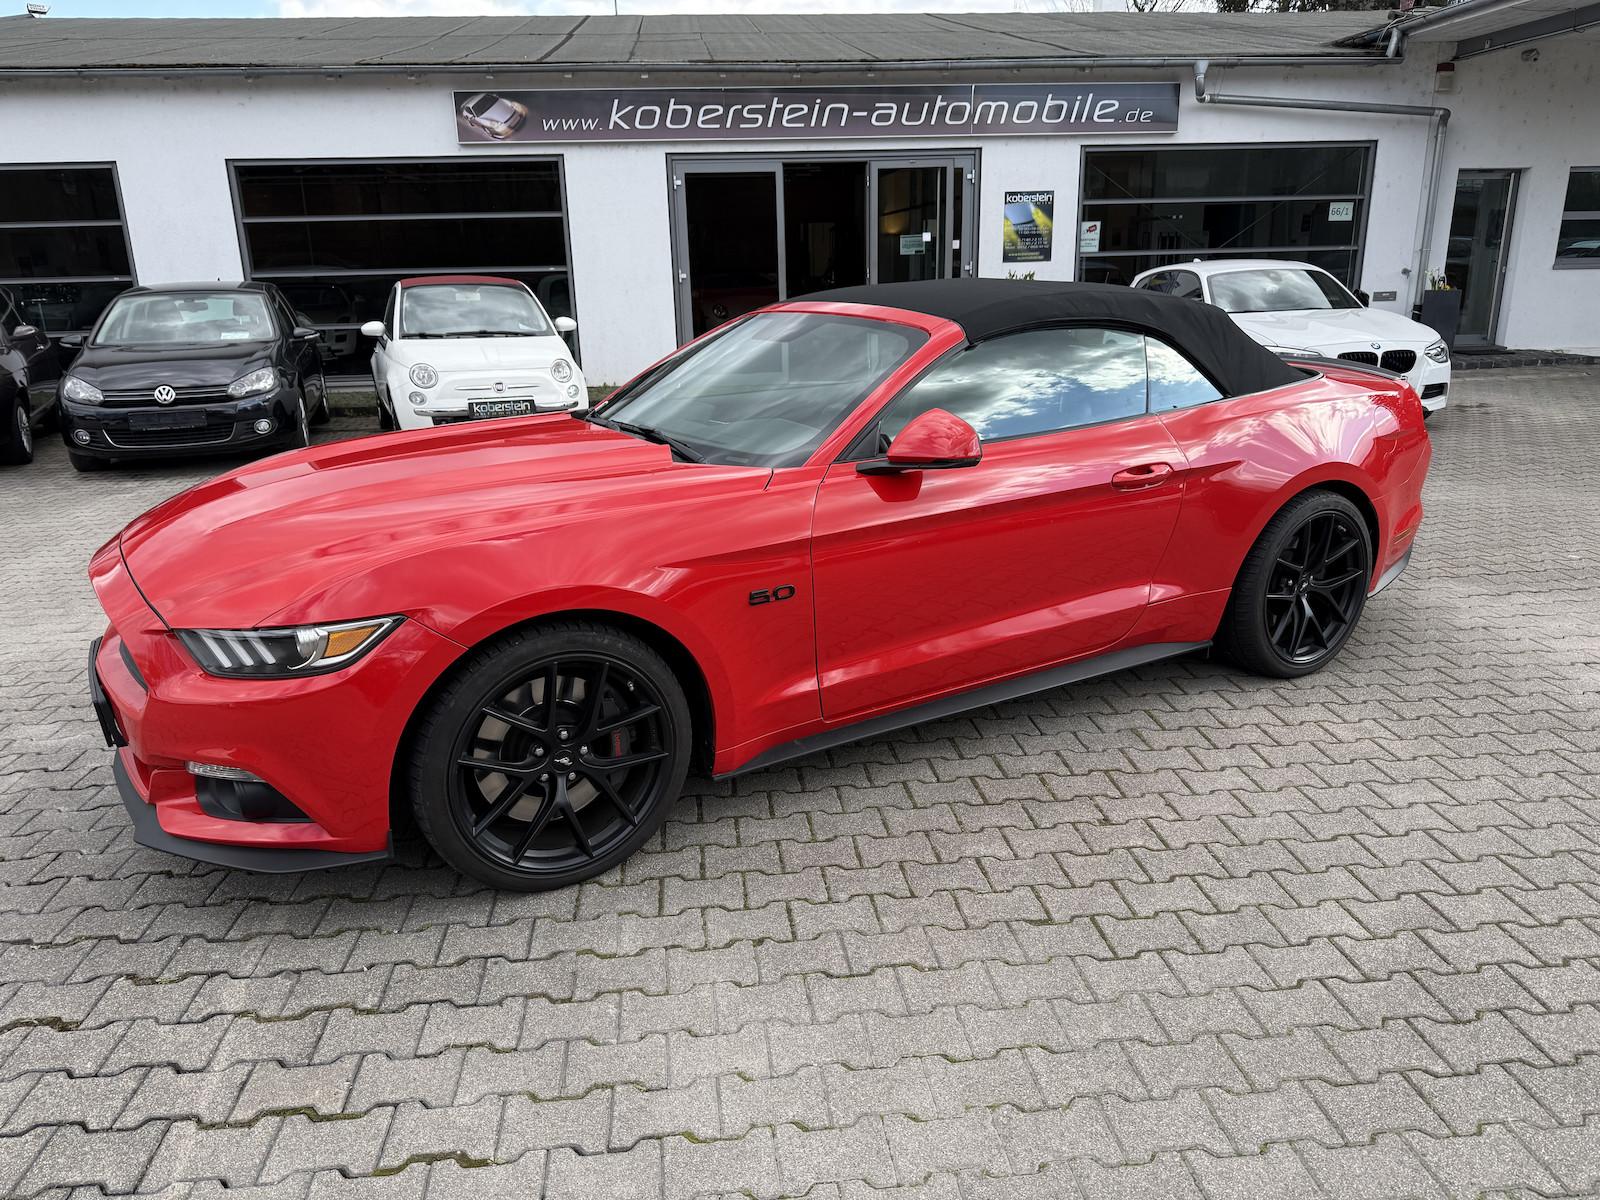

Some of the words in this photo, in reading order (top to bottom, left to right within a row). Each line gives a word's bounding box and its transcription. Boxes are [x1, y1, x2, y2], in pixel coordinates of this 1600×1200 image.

[542, 93, 1153, 132] www.koberstein-automobile.de
[1006, 193, 1053, 203] koberstein
[1331, 207, 1349, 217] 66/1
[473, 401, 531, 413] koberstein
